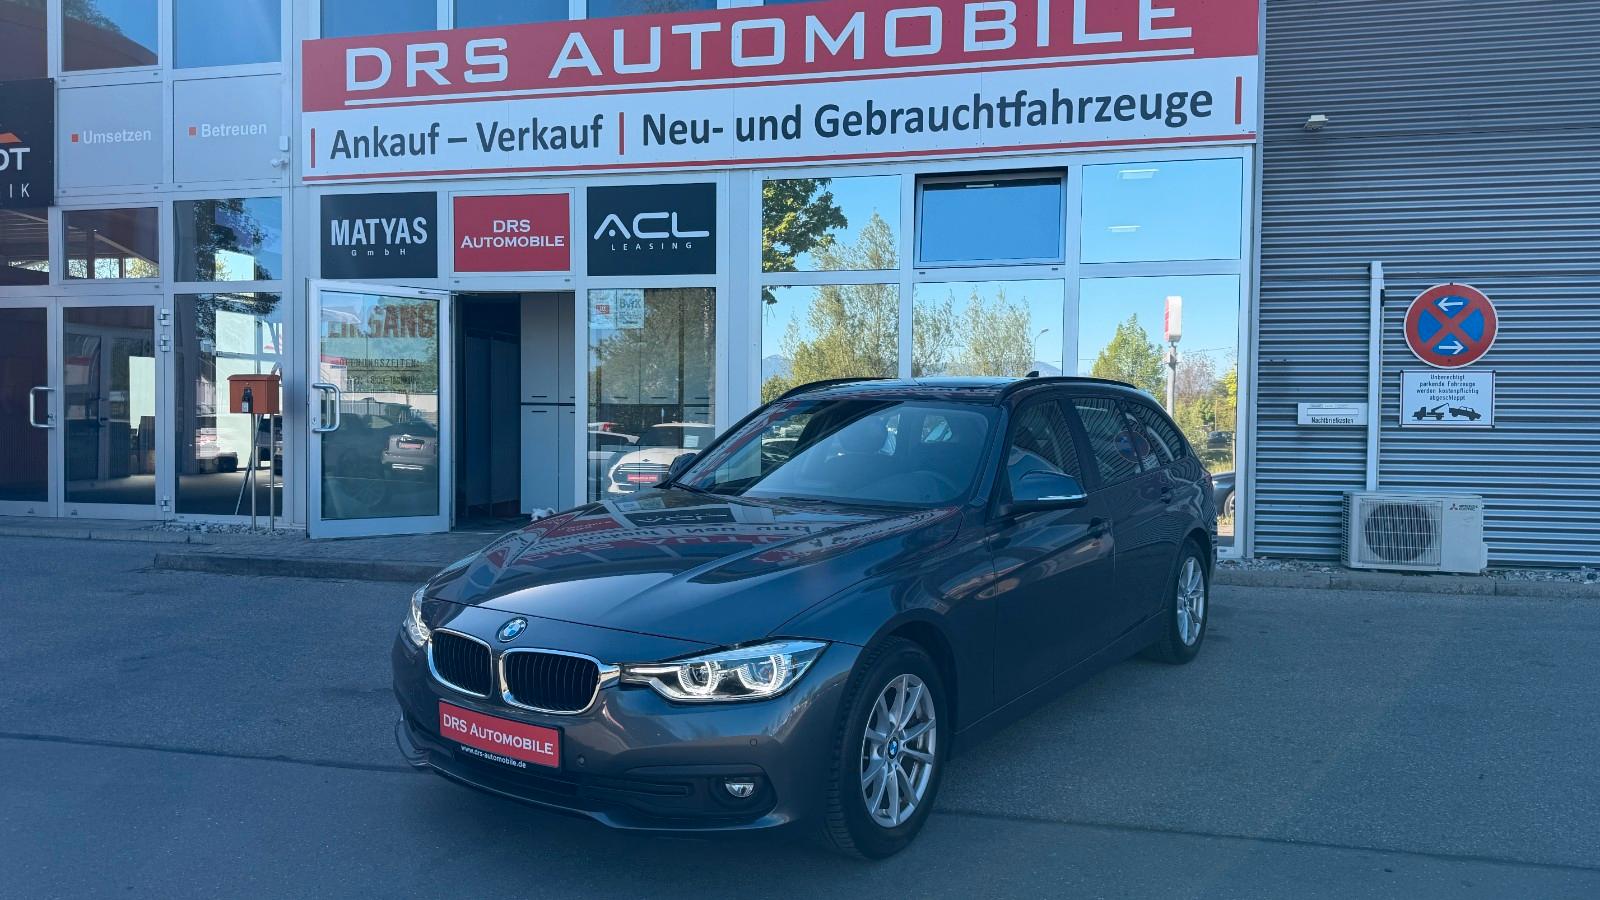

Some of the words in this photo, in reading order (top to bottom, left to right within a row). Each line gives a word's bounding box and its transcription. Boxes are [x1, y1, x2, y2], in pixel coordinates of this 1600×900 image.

[345, 37, 509, 92] DRS
[547, 0, 1193, 80] AUTOMOBILE
[201, 122, 268, 139] Betreuen
[329, 122, 440, 160] Ankauf
[475, 113, 604, 154] Verkauf
[642, 113, 724, 147] Neu-
[735, 103, 802, 143] und
[814, 87, 1214, 138] Gebrauchtfahrzeuge
[83, 129, 152, 145] Umsetzen
[330, 216, 428, 246] MATYAS
[493, 219, 531, 233] DRS
[593, 211, 710, 240] ACL
[351, 248, 406, 257] GmbH
[460, 235, 565, 249] AUTOMOBILE
[611, 241, 692, 251] LEASING
[443, 713, 468, 734] DRS
[469, 722, 555, 756] AUTOMOBILE
[460, 744, 527, 769] www.drs-automobile.de
